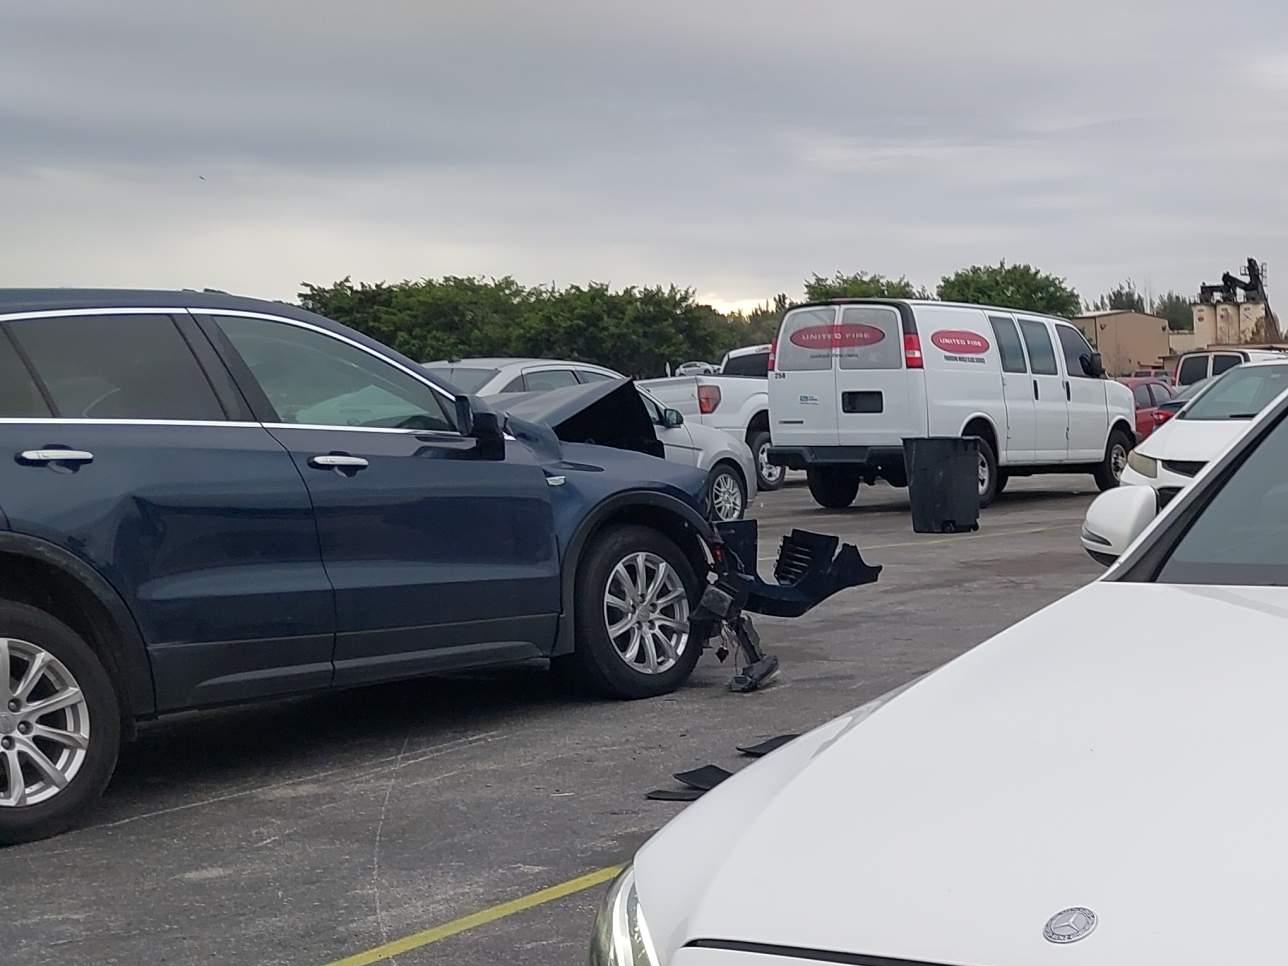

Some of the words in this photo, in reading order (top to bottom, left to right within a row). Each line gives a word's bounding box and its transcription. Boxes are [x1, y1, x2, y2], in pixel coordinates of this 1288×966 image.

[801, 332, 842, 342] UNITED
[845, 332, 871, 340] FIRE
[938, 337, 966, 346] UNITED
[966, 340, 983, 348] FIRE
